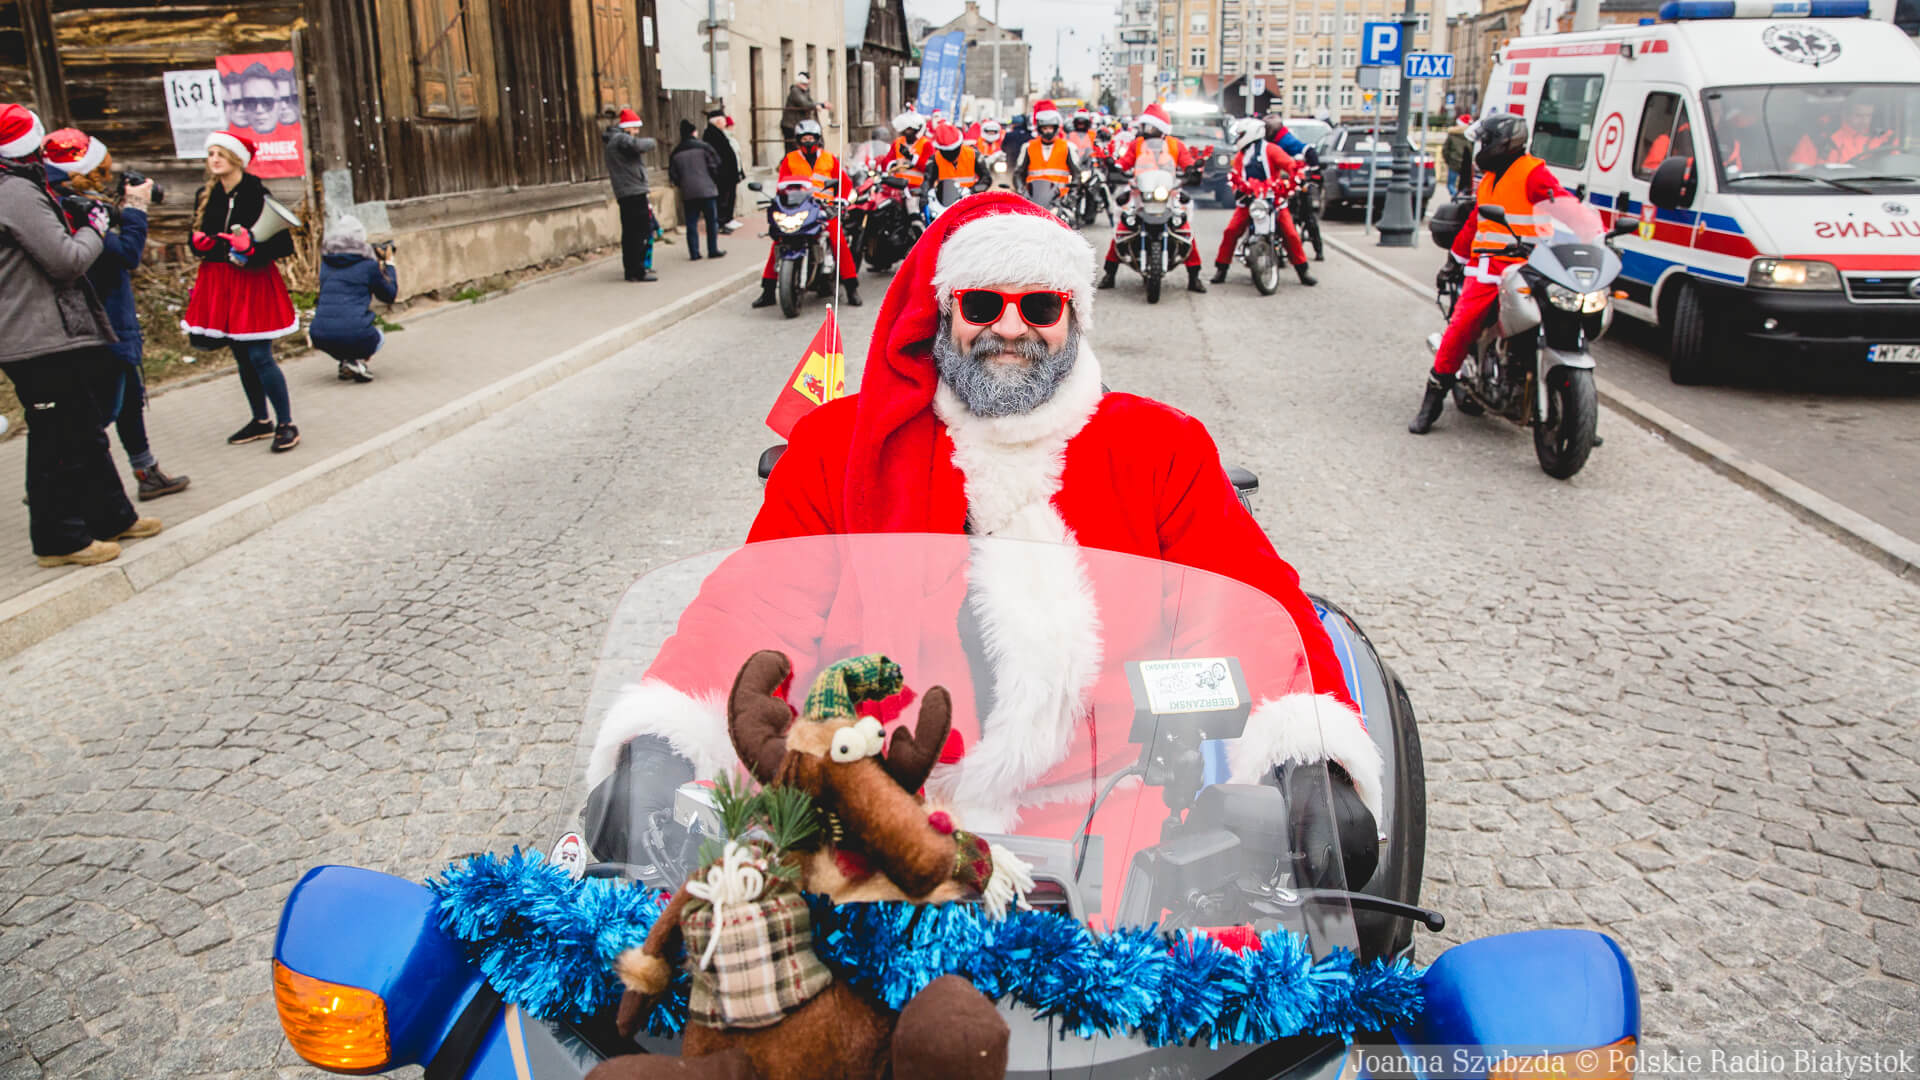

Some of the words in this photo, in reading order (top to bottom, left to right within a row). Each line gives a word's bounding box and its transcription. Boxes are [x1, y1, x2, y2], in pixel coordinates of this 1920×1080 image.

[1370, 26, 1398, 61] P
[1407, 56, 1453, 75] TAXI
[1602, 125, 1618, 161] P
